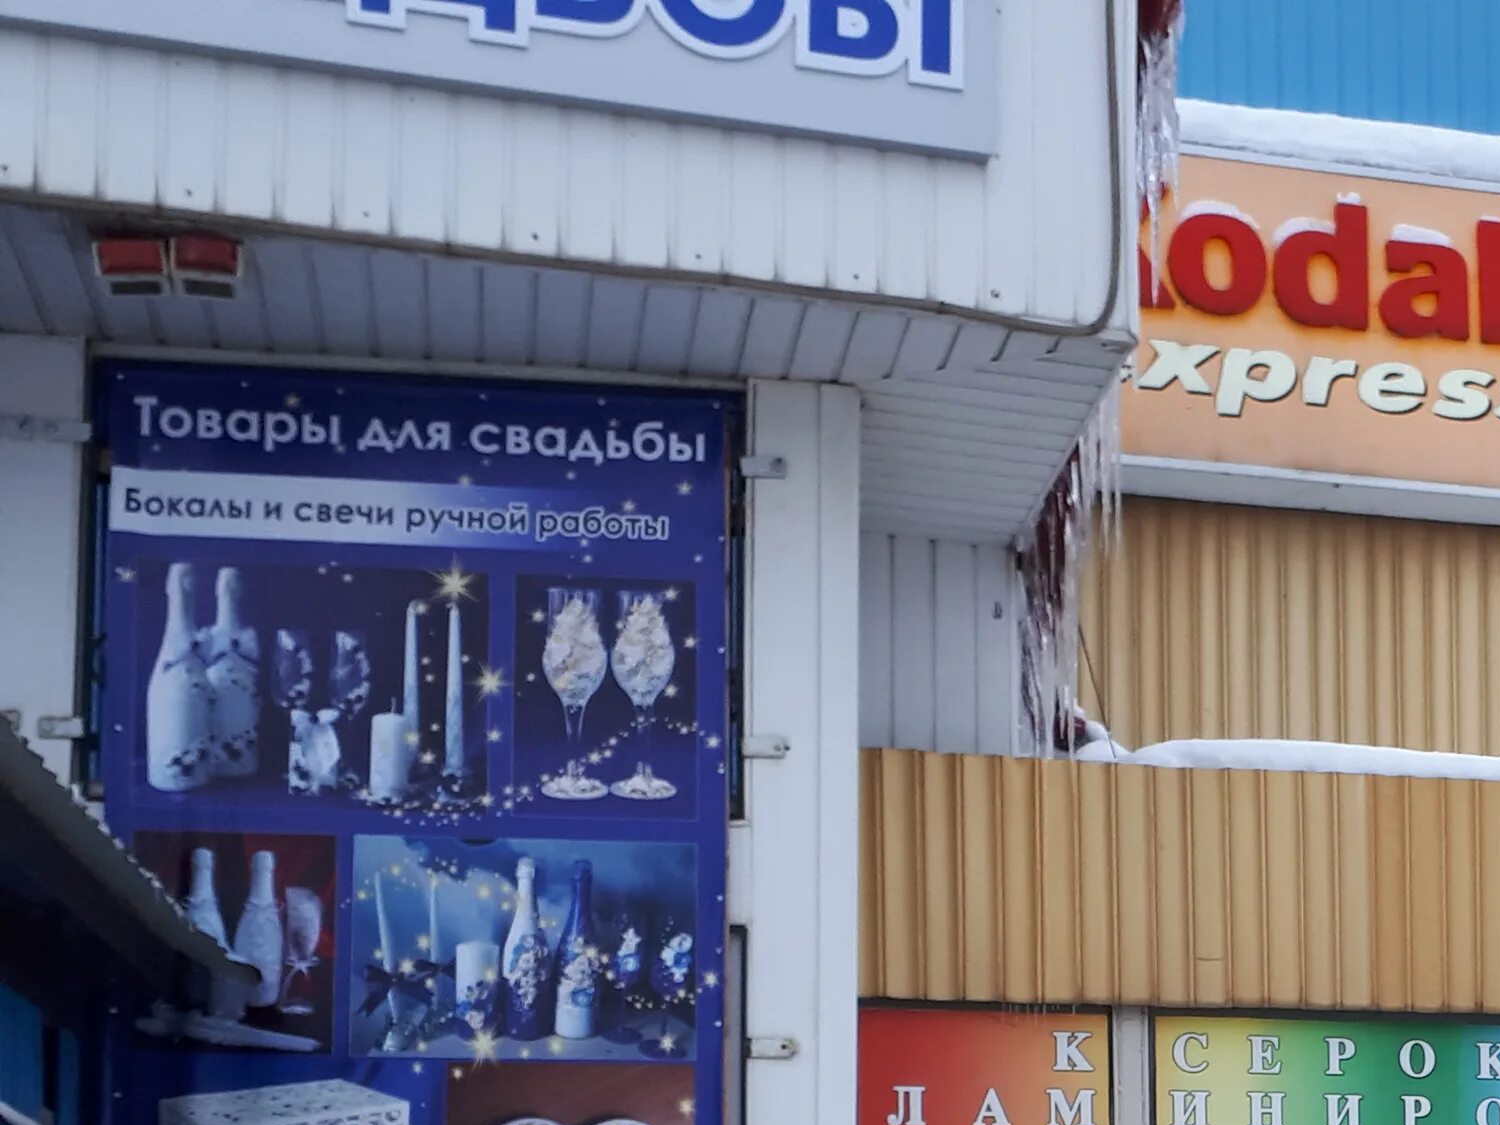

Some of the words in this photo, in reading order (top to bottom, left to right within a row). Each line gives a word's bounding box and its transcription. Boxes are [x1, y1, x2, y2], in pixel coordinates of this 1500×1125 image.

[133, 395, 341, 452] Товары
[356, 418, 452, 453] для
[468, 420, 707, 465] свадьбы
[123, 486, 252, 520] Бокалы
[262, 501, 282, 521] и
[295, 501, 397, 525] свечи
[405, 503, 527, 534] ручной
[536, 506, 670, 541] работы
